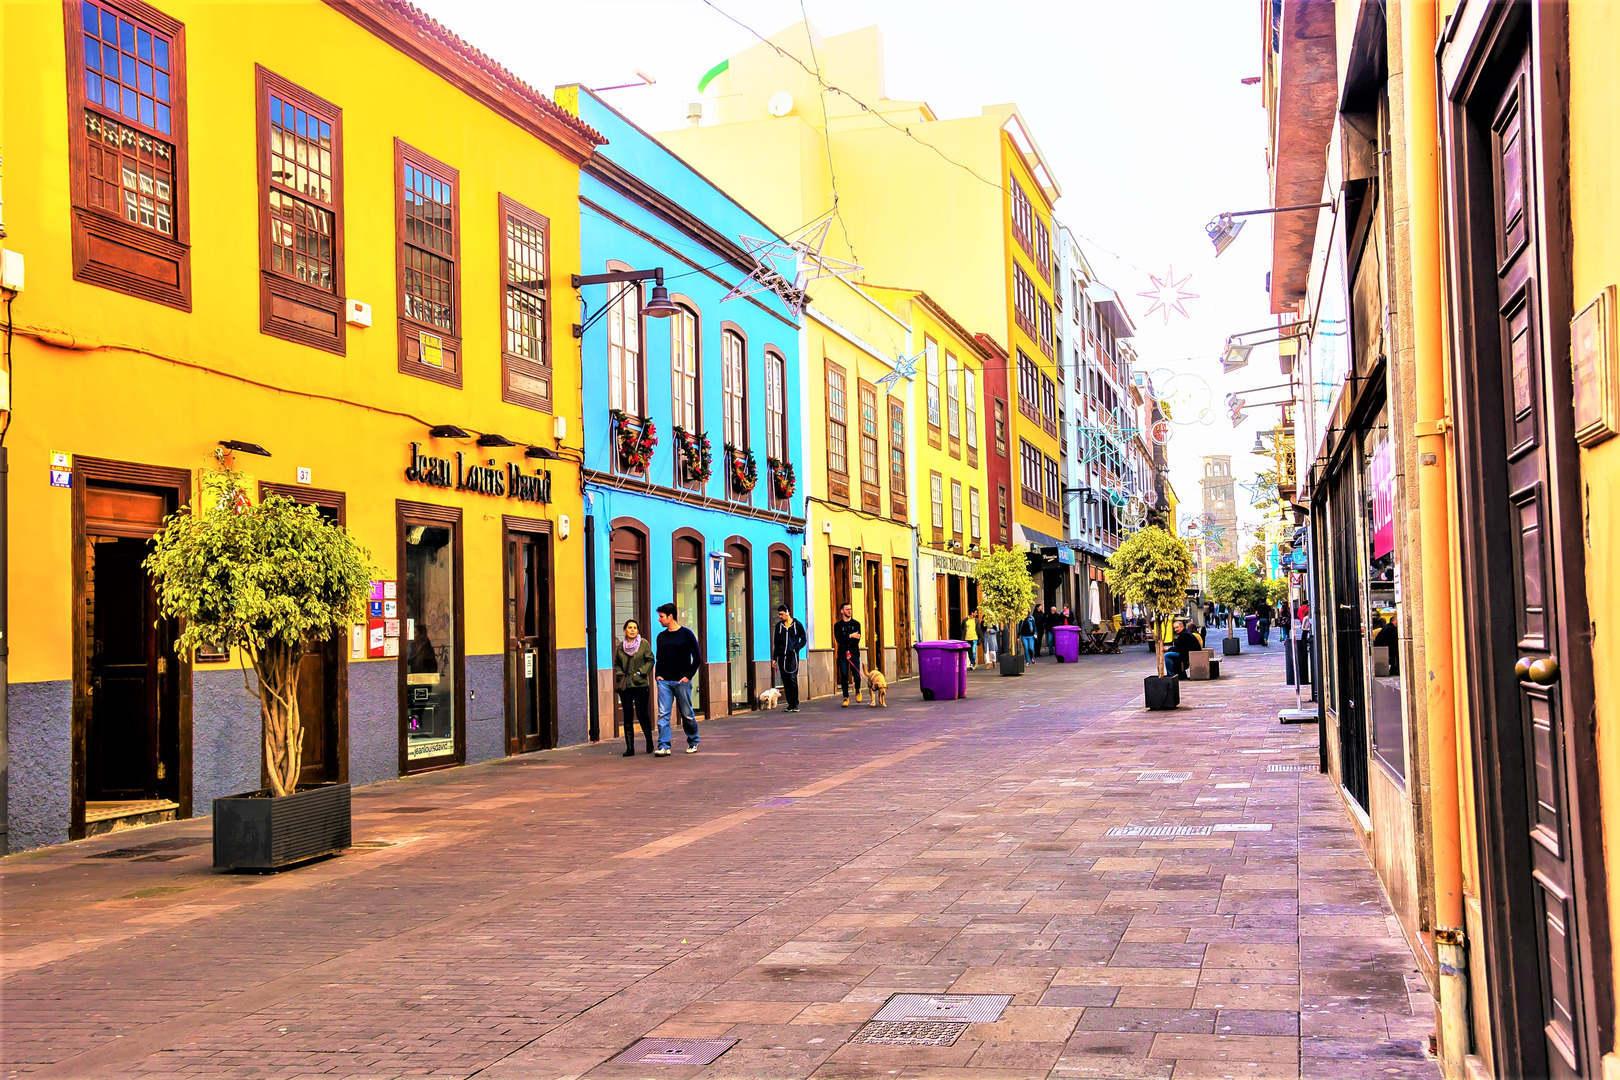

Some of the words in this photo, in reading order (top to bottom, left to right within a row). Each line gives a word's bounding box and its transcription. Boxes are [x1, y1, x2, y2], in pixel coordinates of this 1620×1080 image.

[299, 470, 309, 480] 37
[405, 442, 452, 487] Jean
[456, 451, 505, 496] Louis
[507, 462, 552, 504] David
